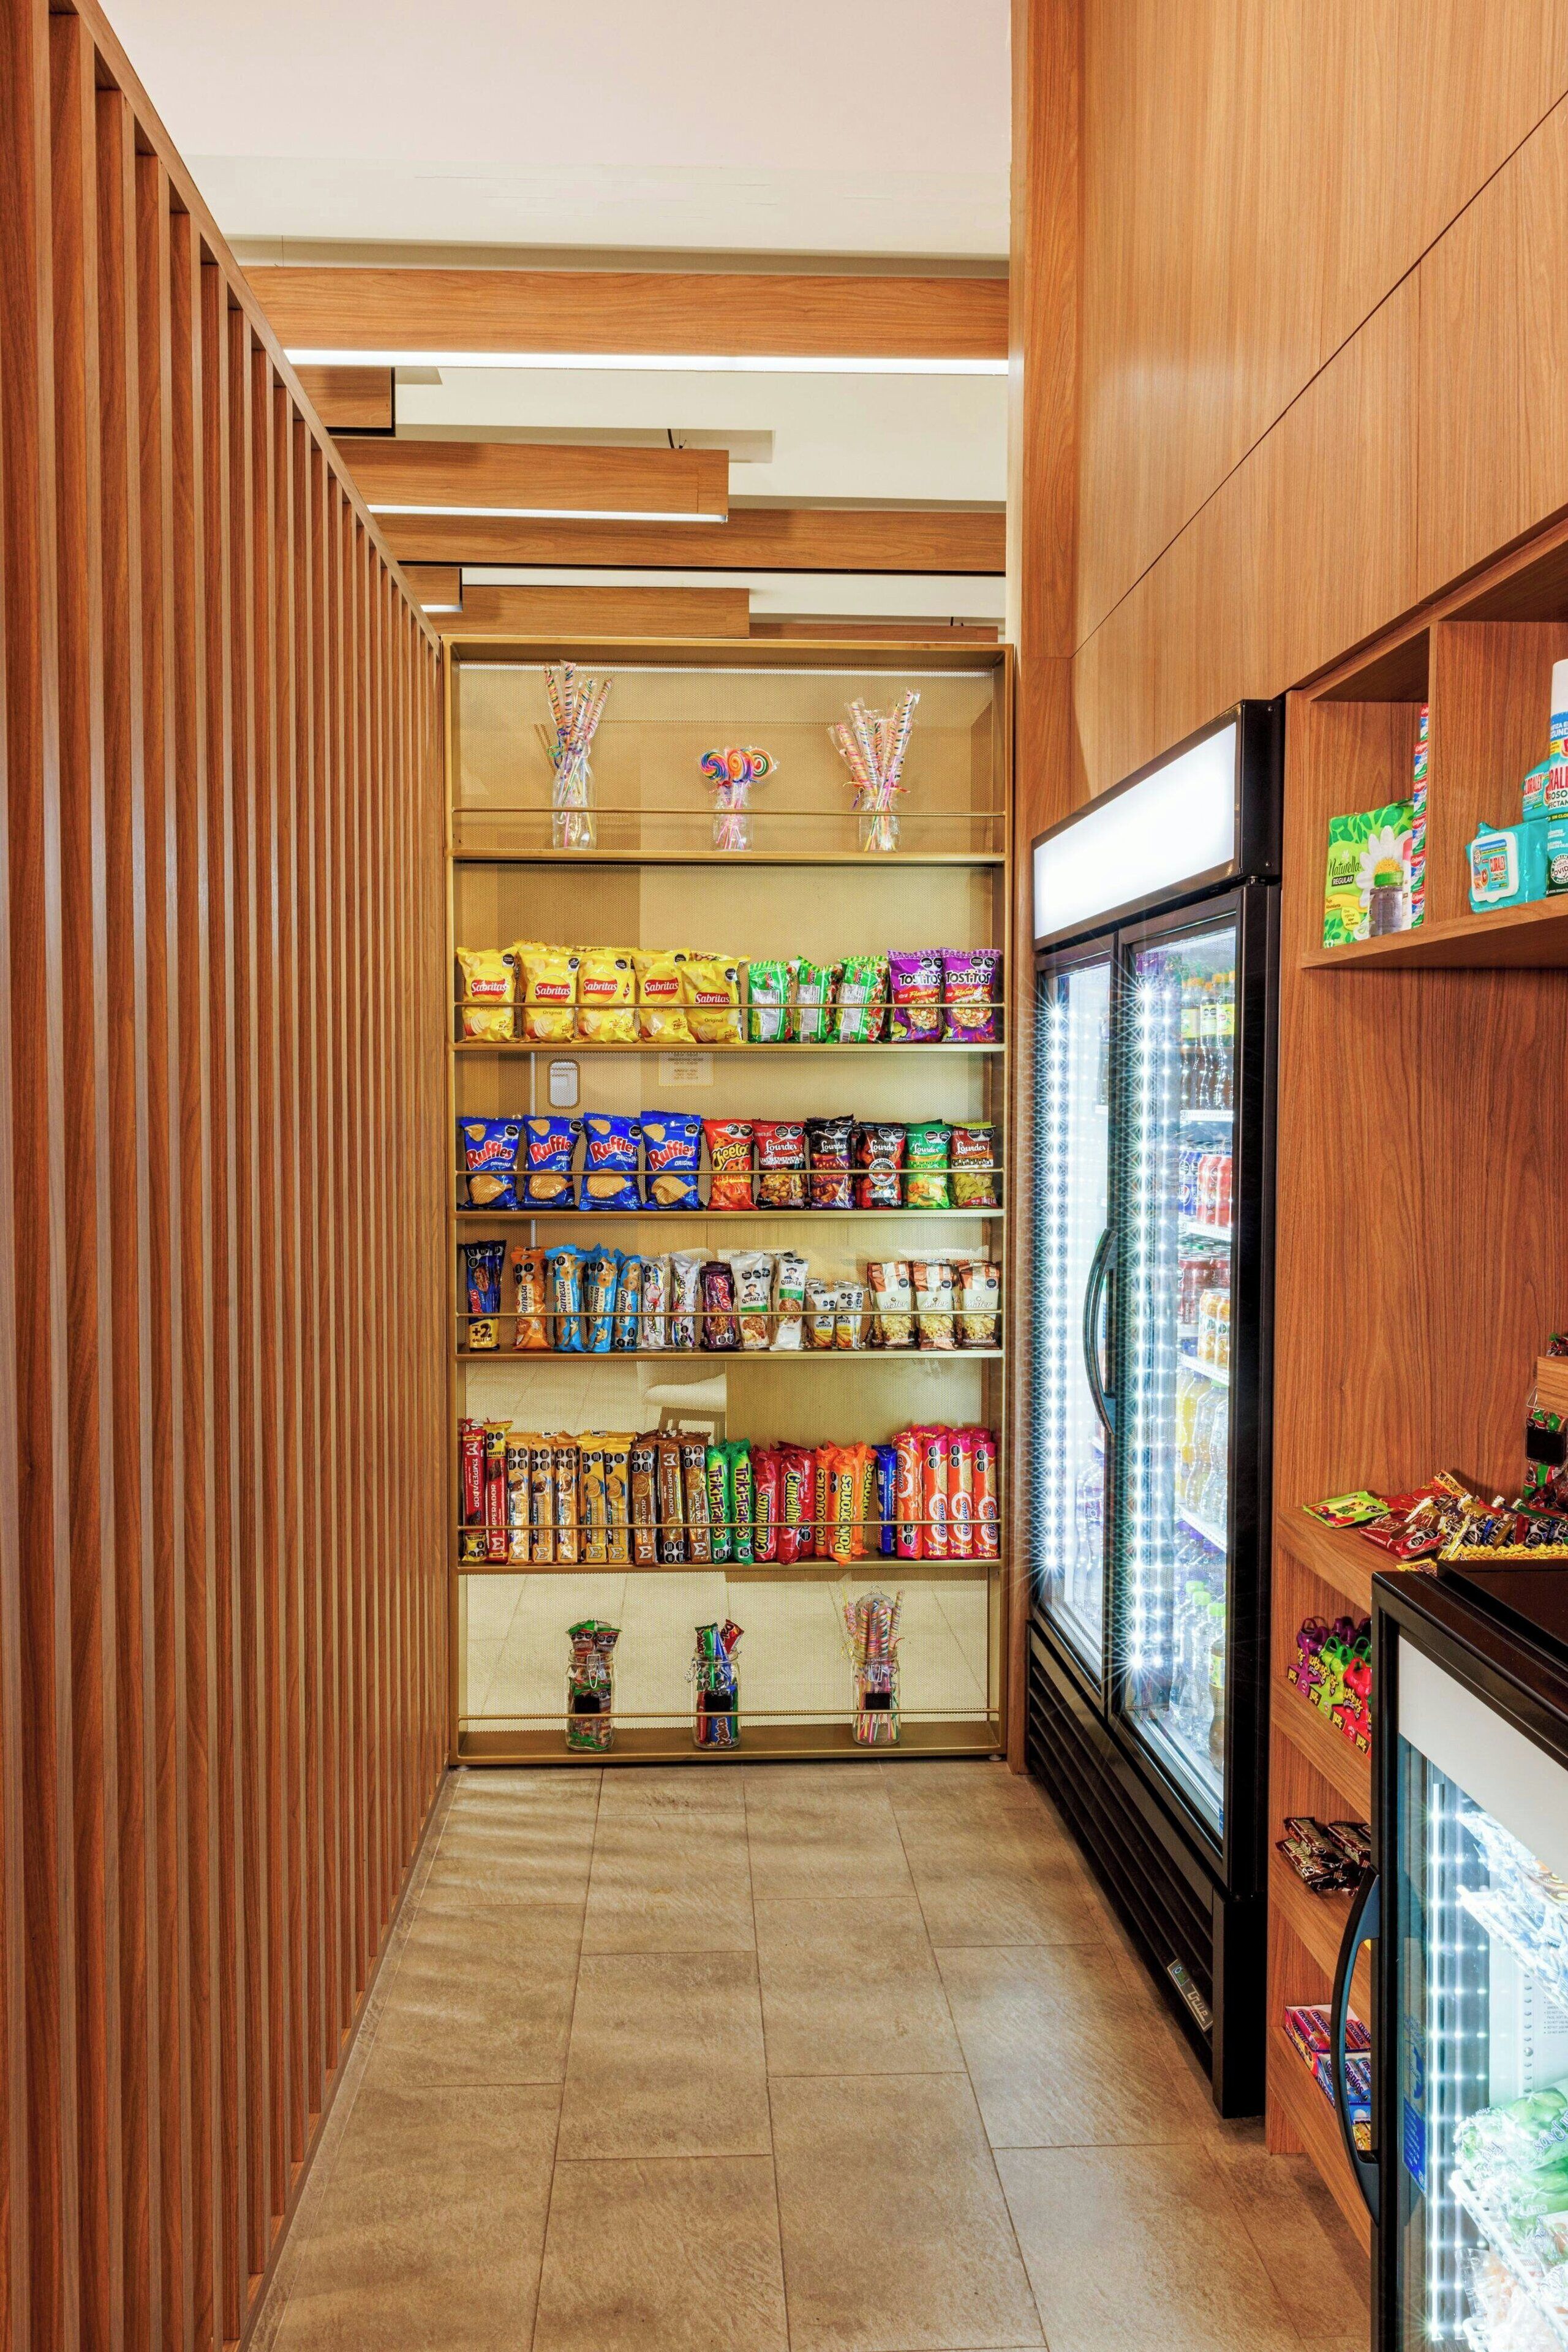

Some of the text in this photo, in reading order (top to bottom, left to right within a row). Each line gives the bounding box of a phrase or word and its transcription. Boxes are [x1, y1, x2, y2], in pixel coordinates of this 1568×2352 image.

[1329, 856, 1361, 876] Naturella
[1333, 876, 1353, 885] REGULAR
[472, 981, 508, 992] Sabritas
[535, 985, 571, 995] Sabritas
[584, 981, 617, 991] Sabritas
[645, 982, 679, 992] Sabritas
[695, 994, 730, 1004] Sabritas
[764, 1140, 797, 1155] Lourdes
[821, 1140, 846, 1153] Lourdes
[869, 1140, 897, 1153] Lourdes
[913, 1143, 938, 1153] Lourdes
[956, 1141, 986, 1155] Lourdes
[466, 1140, 514, 1170] Ruffles
[648, 1140, 695, 1171] Ruffles
[472, 1324, 492, 1338] +2
[1298, 2009, 1316, 2032] mentos
[1347, 2022, 1366, 2045] mentos
